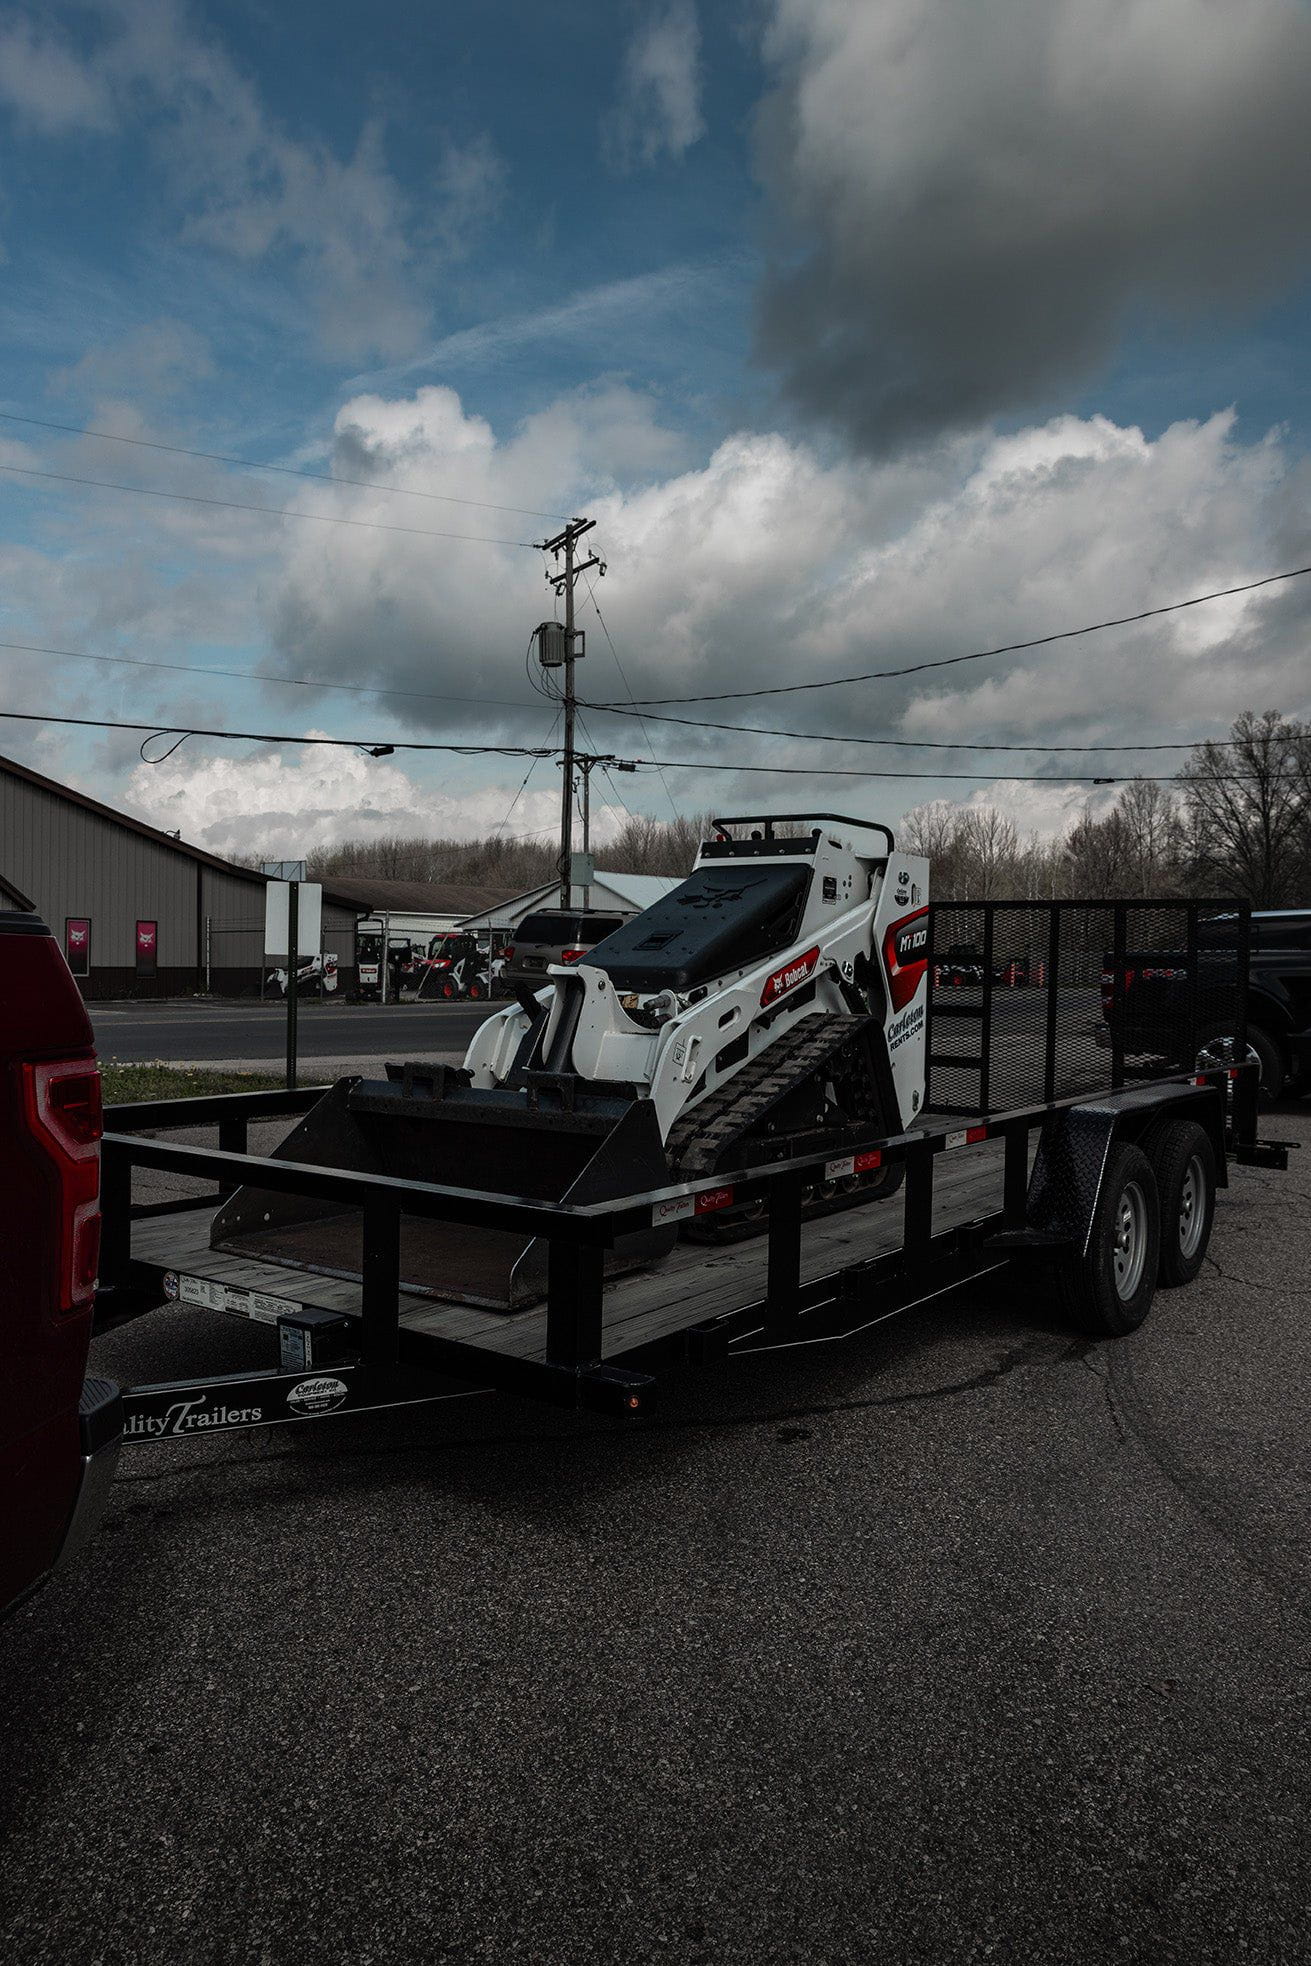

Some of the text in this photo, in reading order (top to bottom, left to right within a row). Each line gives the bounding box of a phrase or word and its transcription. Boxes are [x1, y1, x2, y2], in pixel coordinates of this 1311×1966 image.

[784, 961, 808, 988] Bobcat
[889, 1020, 924, 1052] RENTS.COM
[123, 1394, 263, 1436] lity Trailers
